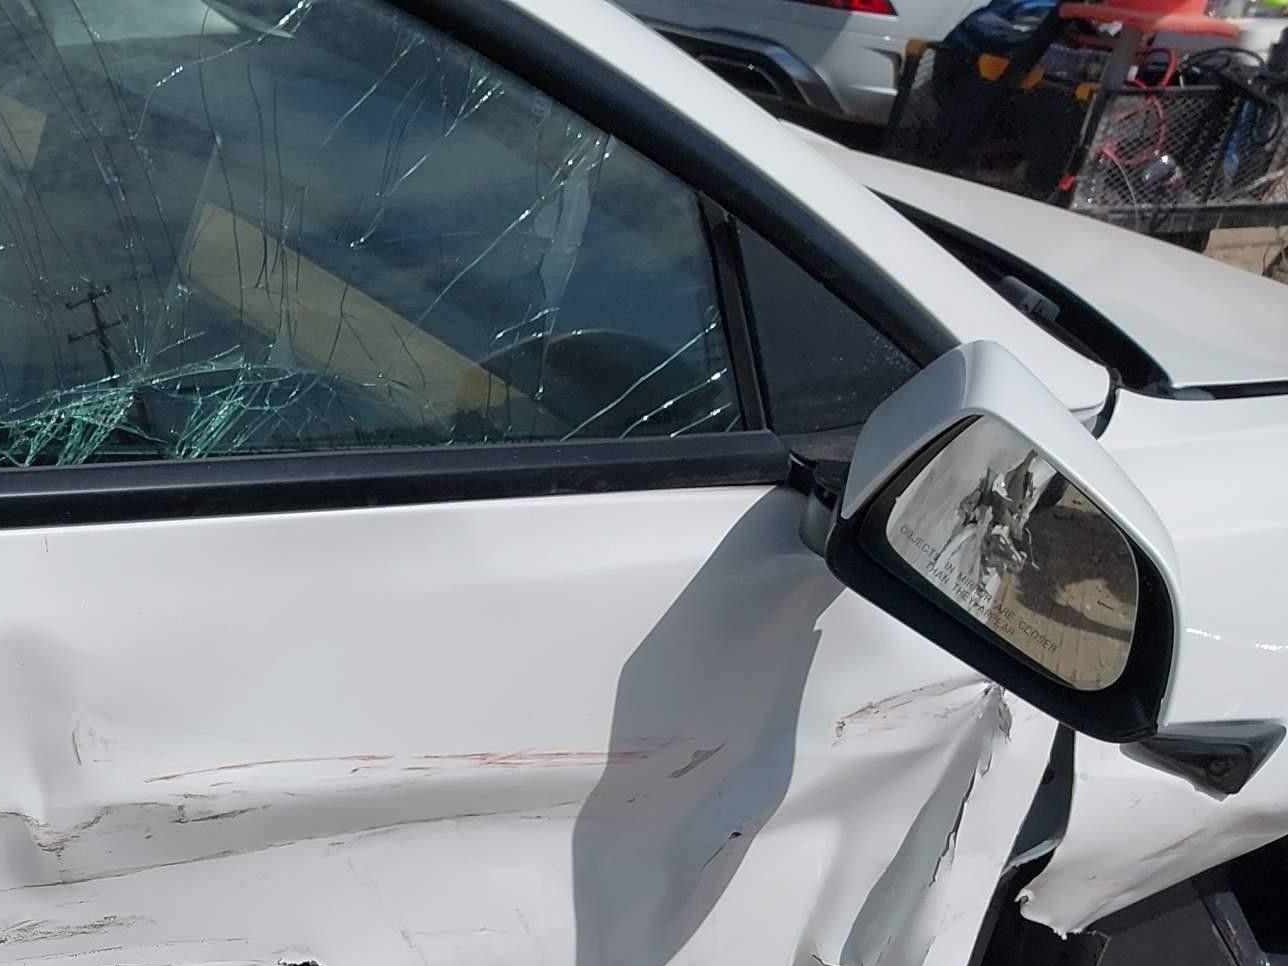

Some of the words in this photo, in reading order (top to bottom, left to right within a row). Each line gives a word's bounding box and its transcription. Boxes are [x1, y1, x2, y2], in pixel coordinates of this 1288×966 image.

[900, 524, 941, 562] OBJECTS
[944, 561, 956, 574] IN
[997, 604, 1016, 620] ARE
[1018, 620, 1058, 653] CLOSER
[925, 560, 950, 584] THAN
[952, 583, 976, 605] THEY
